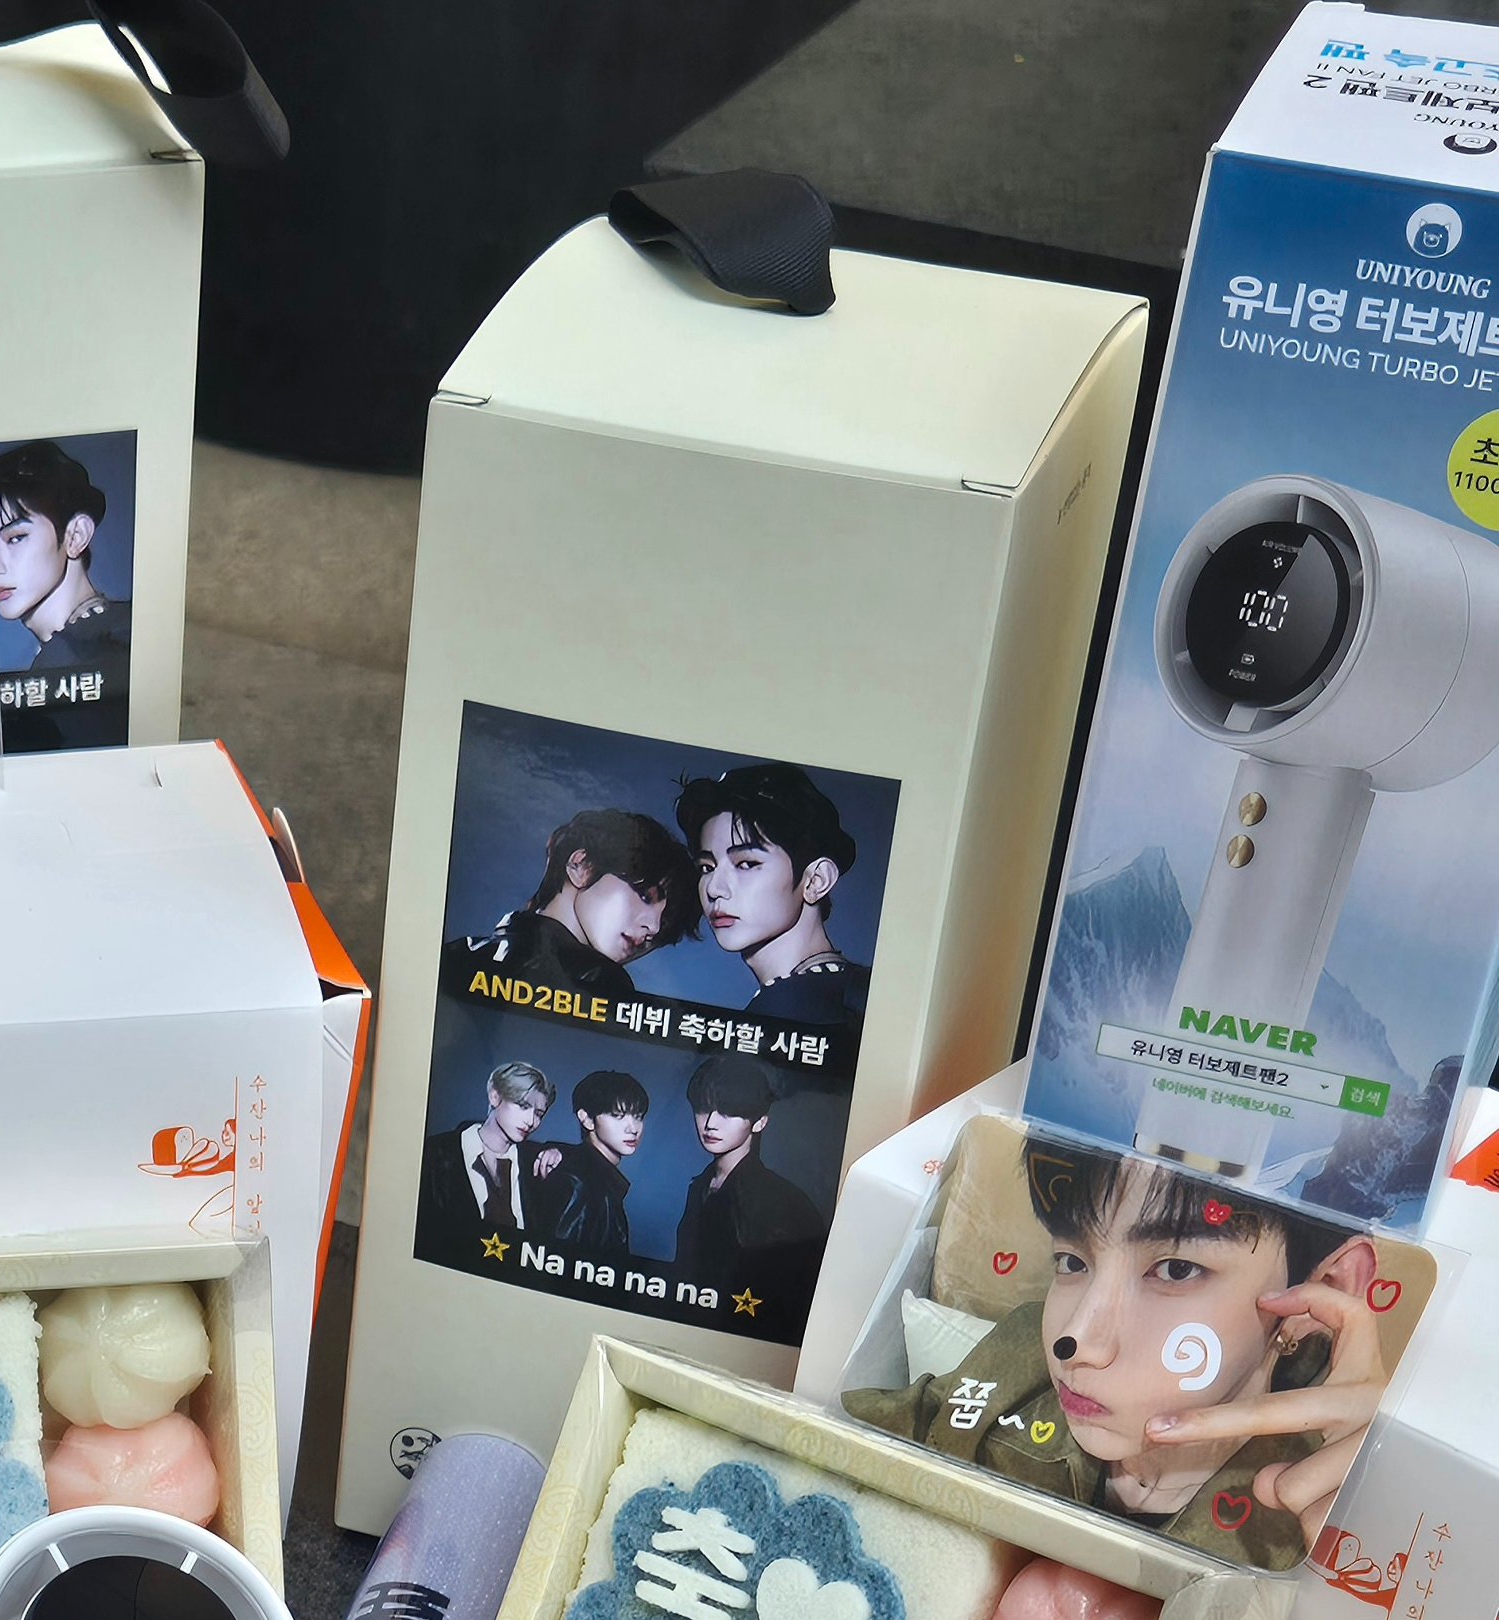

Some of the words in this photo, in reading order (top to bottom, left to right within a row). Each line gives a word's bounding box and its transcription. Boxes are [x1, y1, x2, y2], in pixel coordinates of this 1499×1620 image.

[1302, 74, 1333, 90] 2
[1336, 65, 1387, 80] FAN
[1413, 113, 1499, 132] YOUNG
[1356, 259, 1491, 298] UNIYOUNG
[1222, 275, 1348, 333] 유니영
[1219, 327, 1360, 369] UNIYOUNG
[1368, 352, 1459, 385] TURBO
[1238, 590, 1289, 632] 100
[54, 670, 104, 703] 사람
[468, 970, 609, 1025] AND2BLE
[614, 1001, 672, 1038] 데뷔
[677, 1013, 765, 1055] 축하할
[770, 1030, 830, 1066] 사람
[1178, 1006, 1317, 1057] NAVER
[1130, 1039, 1184, 1064] 유니영
[1187, 1052, 1289, 1088] 터보제트팬2
[1350, 1085, 1381, 1107] 검색
[249, 1074, 267, 1172] 수잔나의
[519, 1242, 565, 1277] Na
[573, 1259, 616, 1287] na
[624, 1269, 668, 1299] na
[675, 1279, 719, 1308] na
